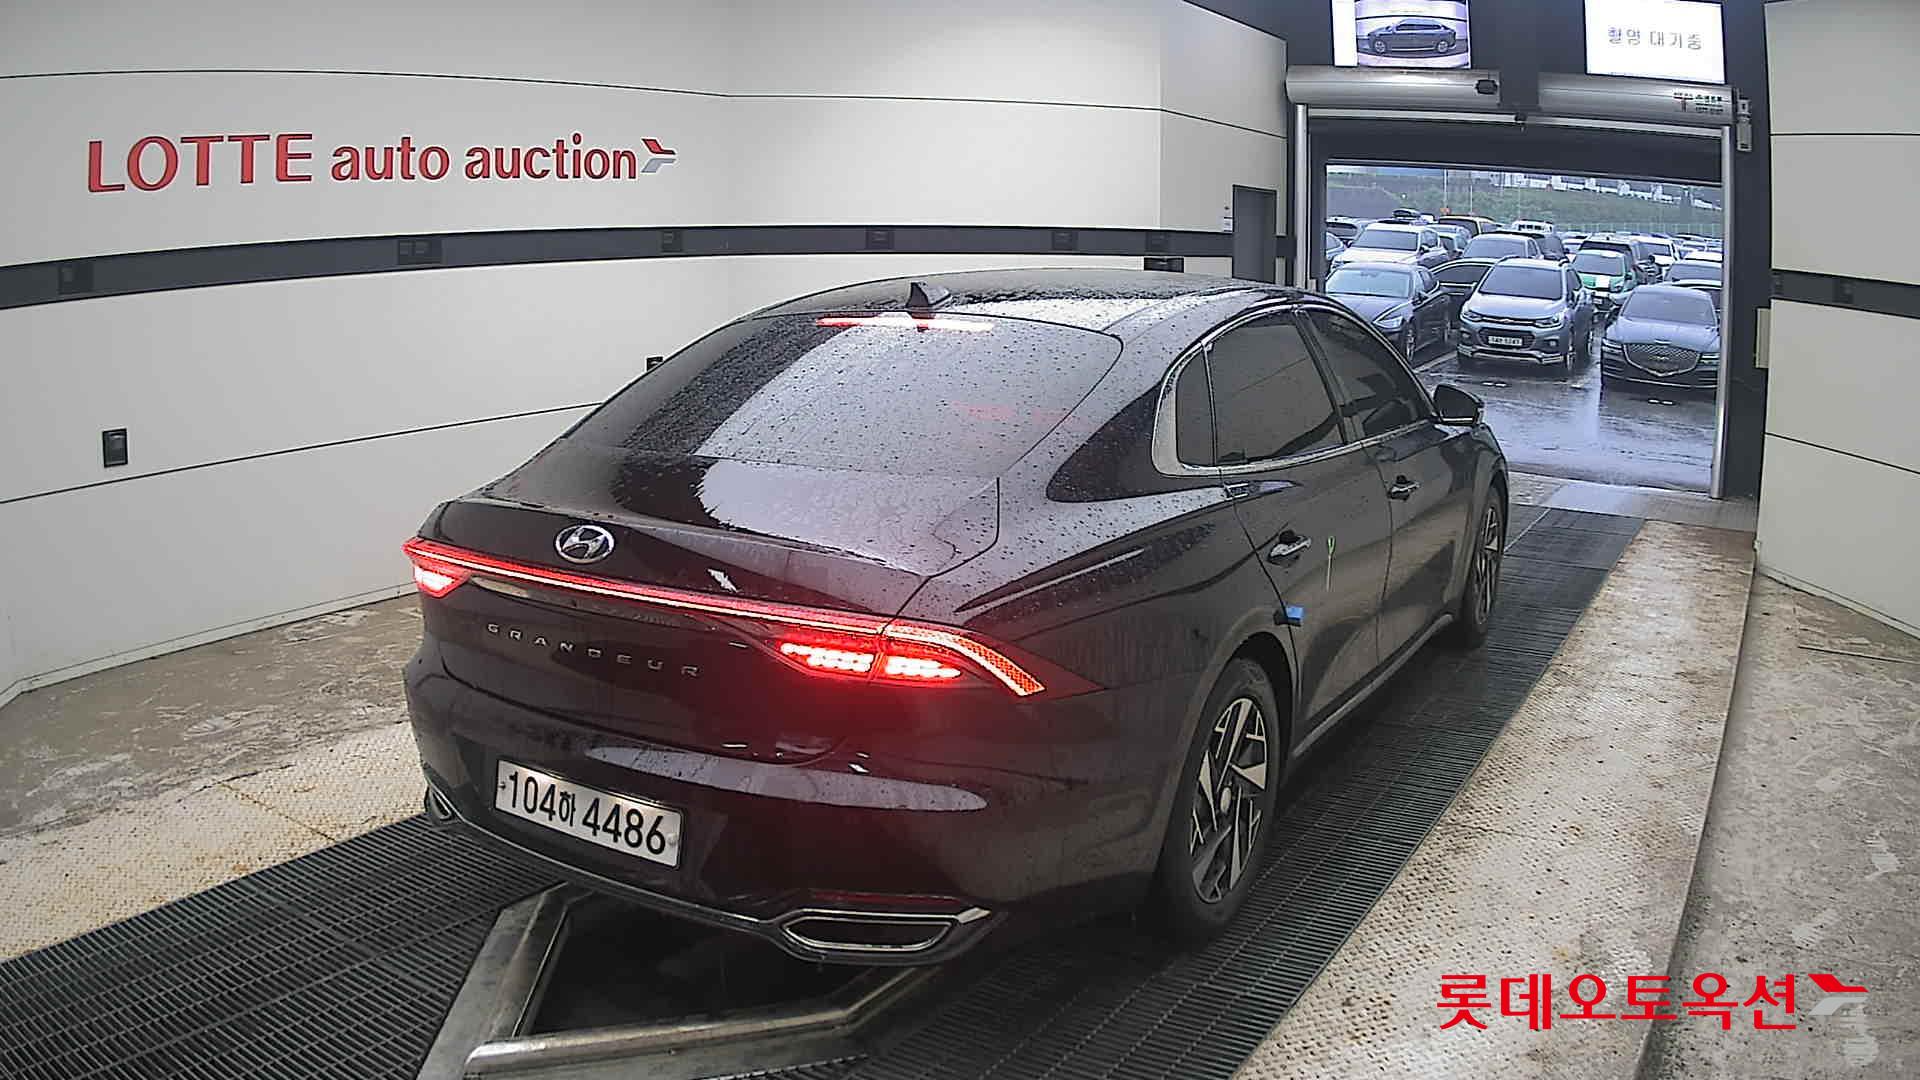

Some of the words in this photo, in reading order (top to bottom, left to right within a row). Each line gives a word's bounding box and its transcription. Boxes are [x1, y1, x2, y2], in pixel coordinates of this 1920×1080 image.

[88, 133, 312, 193] LOTTE
[330, 135, 450, 182] auto
[464, 133, 638, 181] auction
[487, 623, 700, 677] GRANDEUR
[508, 772, 576, 826] 104하
[582, 797, 666, 856] 4486
